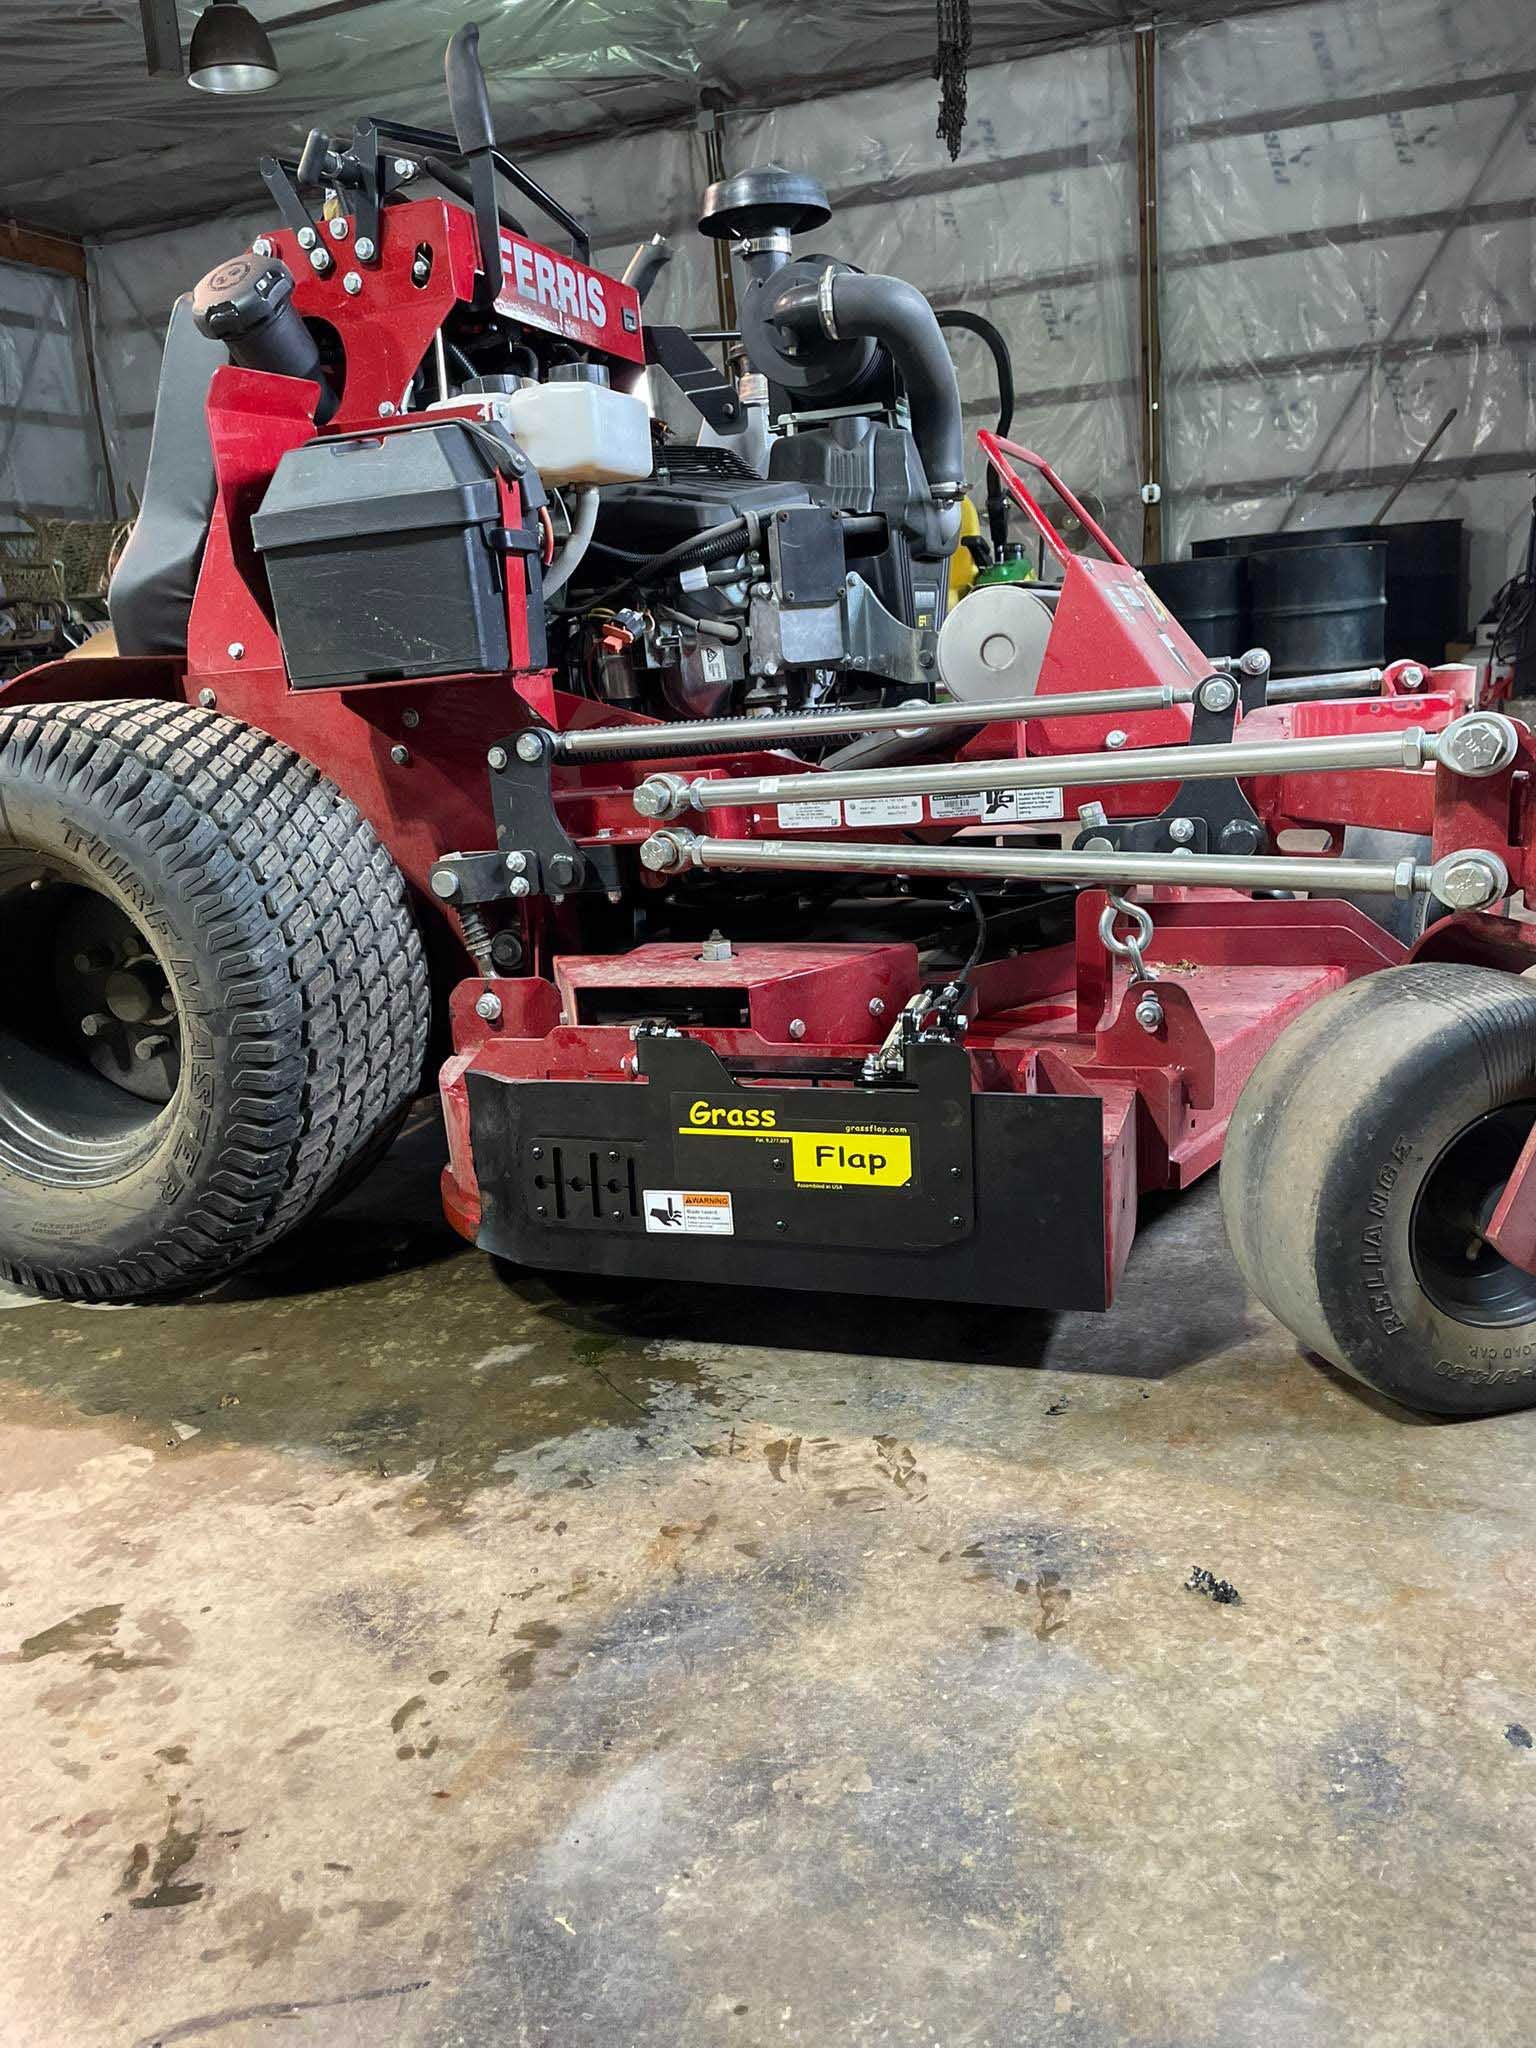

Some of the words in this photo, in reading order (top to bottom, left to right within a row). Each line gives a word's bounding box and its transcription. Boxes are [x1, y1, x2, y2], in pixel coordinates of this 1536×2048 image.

[500, 236, 606, 328] FERRIS
[160, 958, 216, 1206] MASTER
[689, 1100, 776, 1127] Grass
[845, 1124, 907, 1134] grassflap.com
[816, 1145, 887, 1175] Flap
[691, 1197, 728, 1205] WARNING
[1363, 1136, 1412, 1335] RELIANCE
